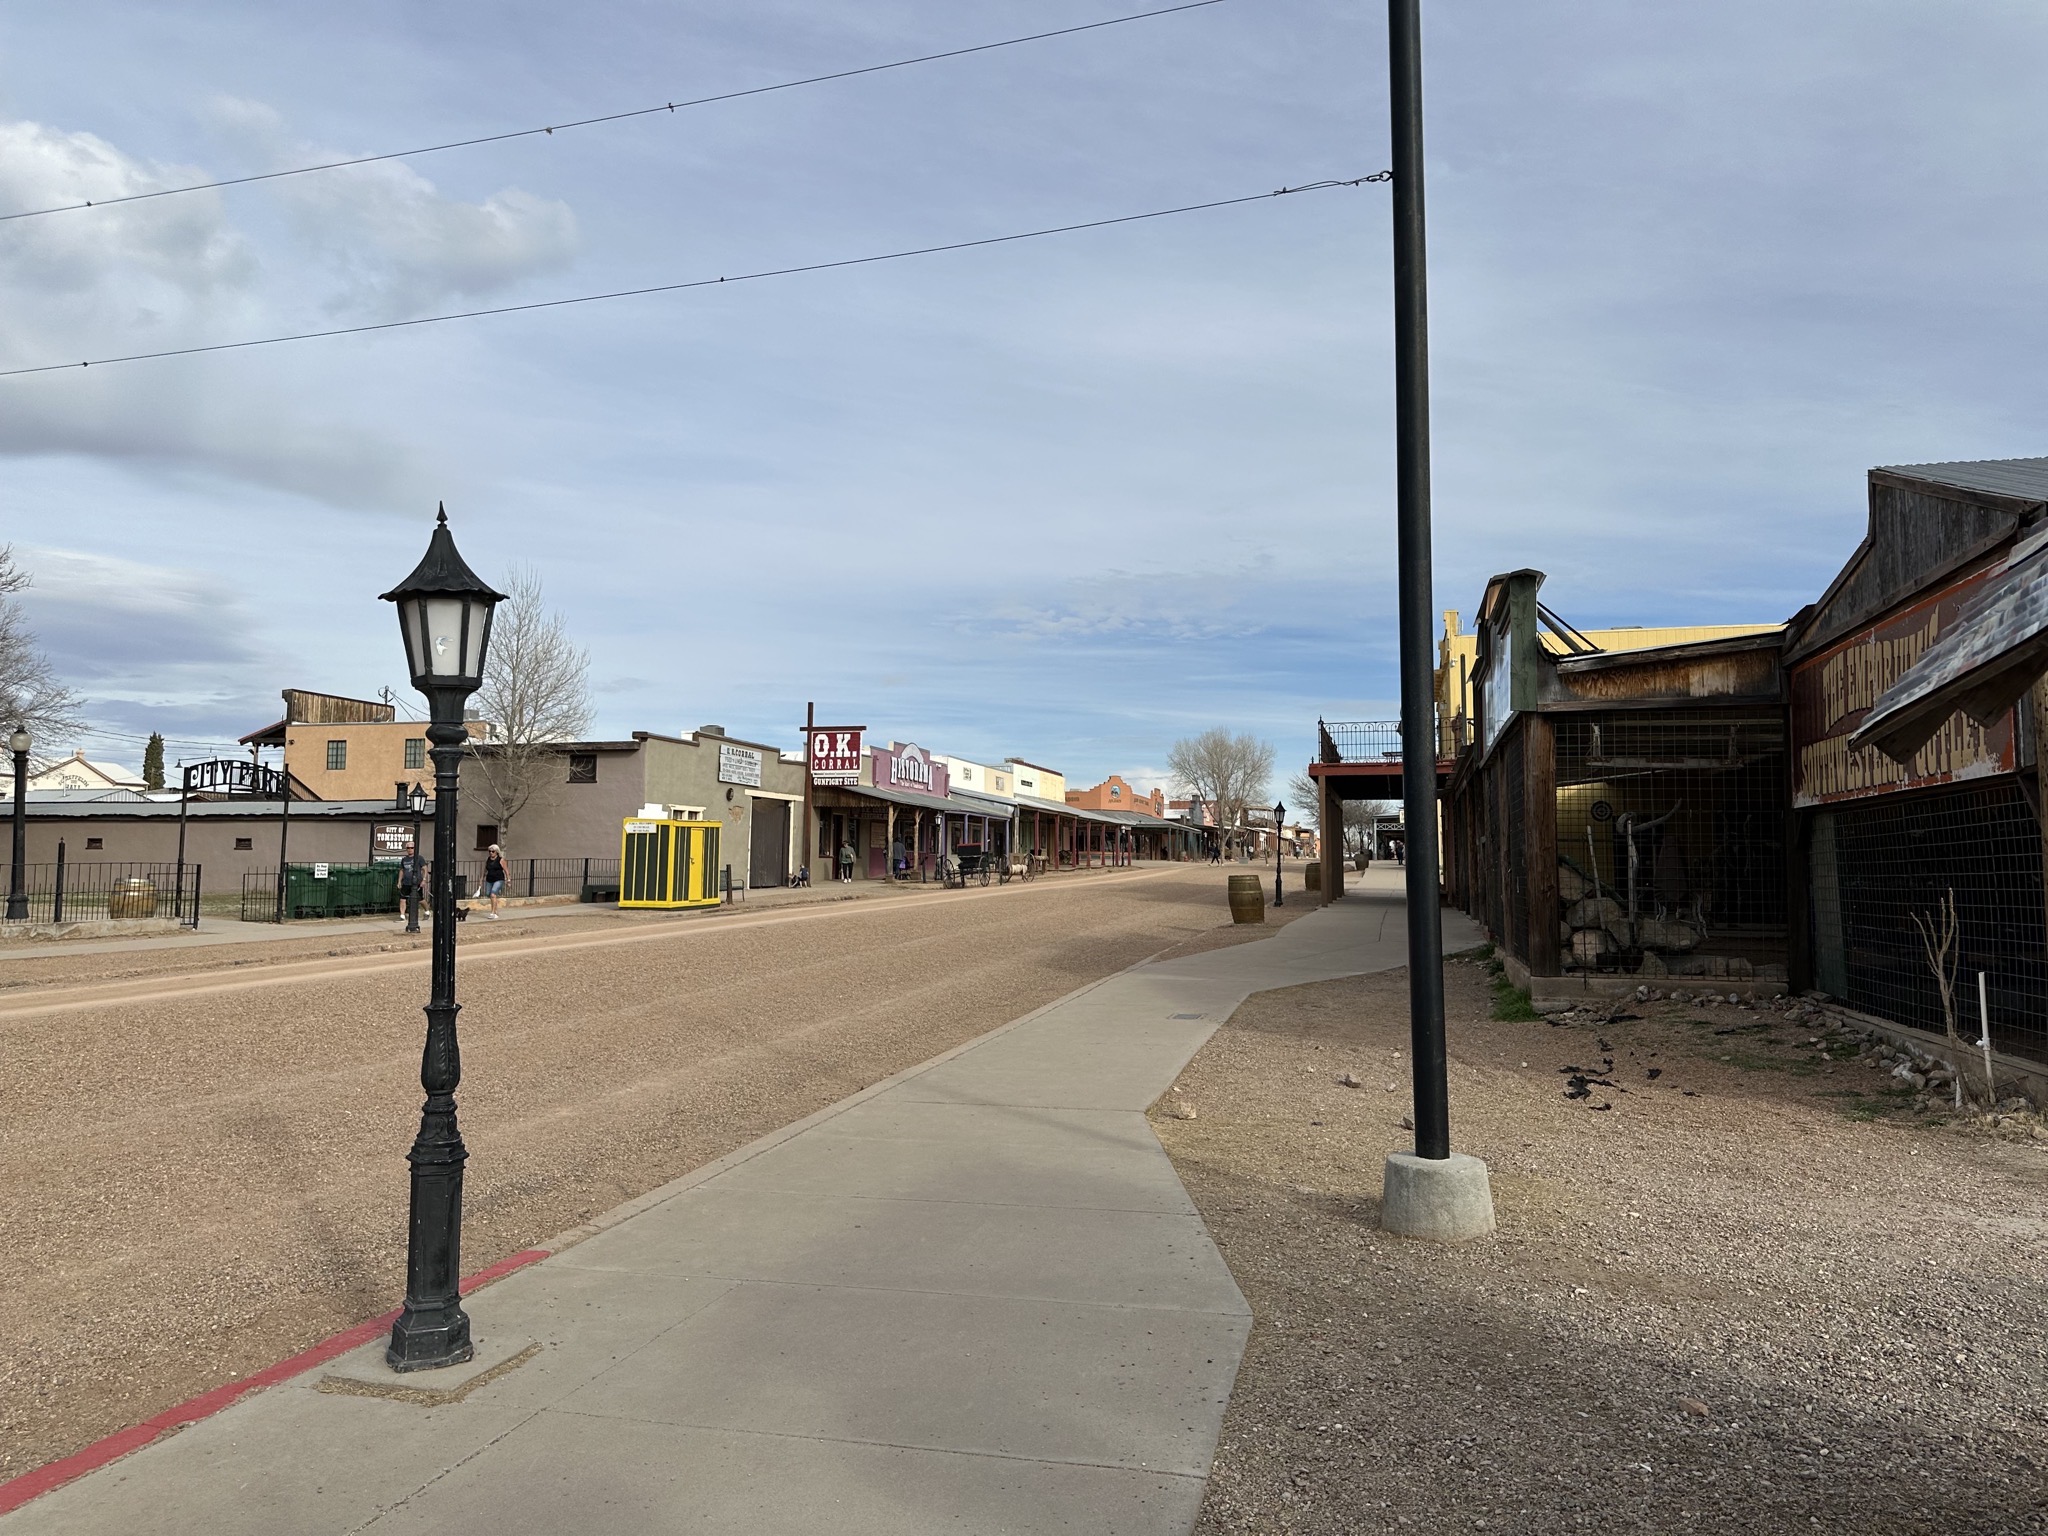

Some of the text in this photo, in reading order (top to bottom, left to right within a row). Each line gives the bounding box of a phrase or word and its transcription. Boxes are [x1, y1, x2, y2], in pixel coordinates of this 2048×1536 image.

[1823, 650, 1845, 735] THE
[814, 734, 857, 758] O.K.
[814, 759, 858, 769] CORRAL
[189, 760, 232, 789] CITY
[814, 777, 858, 785] GUNFIGHT SITE
[890, 756, 933, 791] HISTORAMA
[377, 833, 414, 841] TOMBSTONE
[386, 842, 403, 850] PARK
